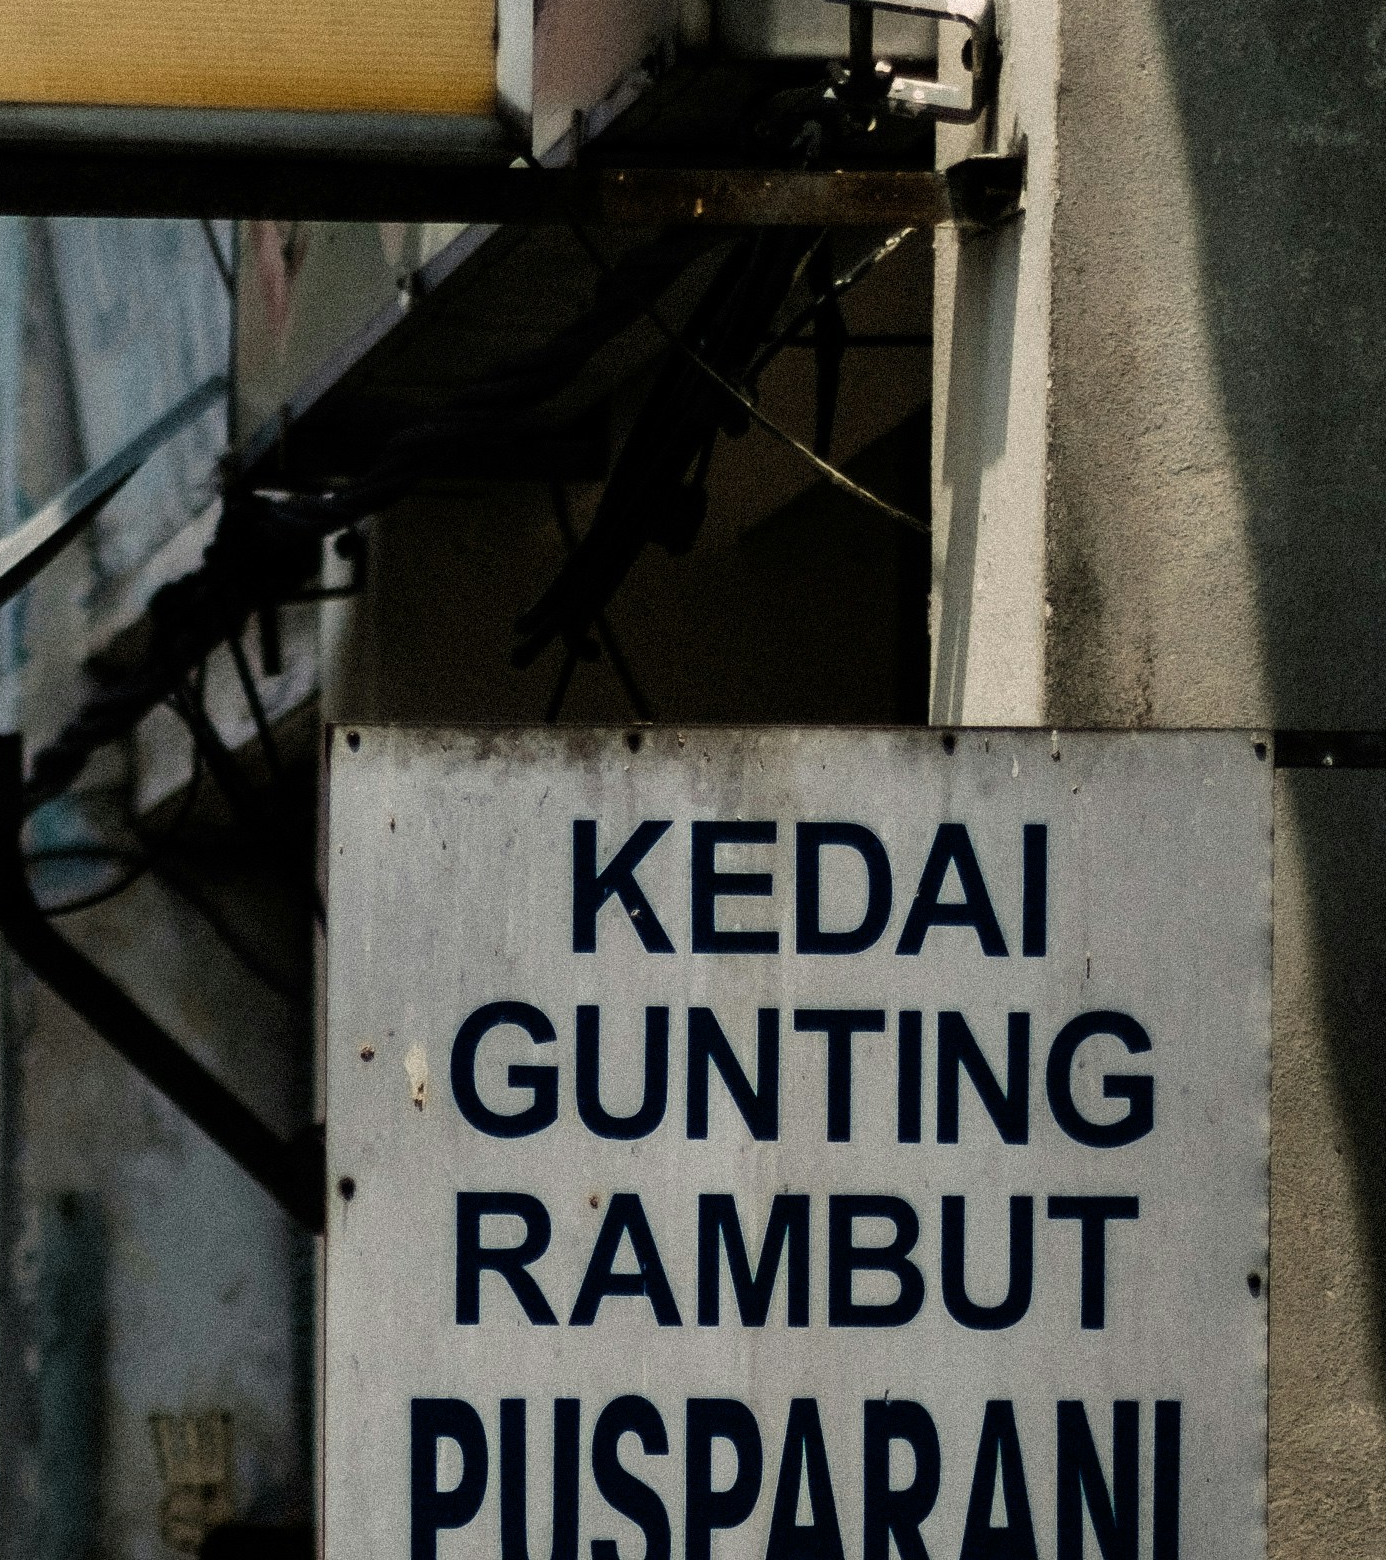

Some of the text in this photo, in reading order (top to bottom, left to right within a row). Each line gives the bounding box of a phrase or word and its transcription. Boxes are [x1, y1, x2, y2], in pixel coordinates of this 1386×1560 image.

[571, 819, 1049, 958] KEDAI
[449, 1000, 1155, 1149] GUNTING
[454, 1191, 1140, 1331] RAMBUT
